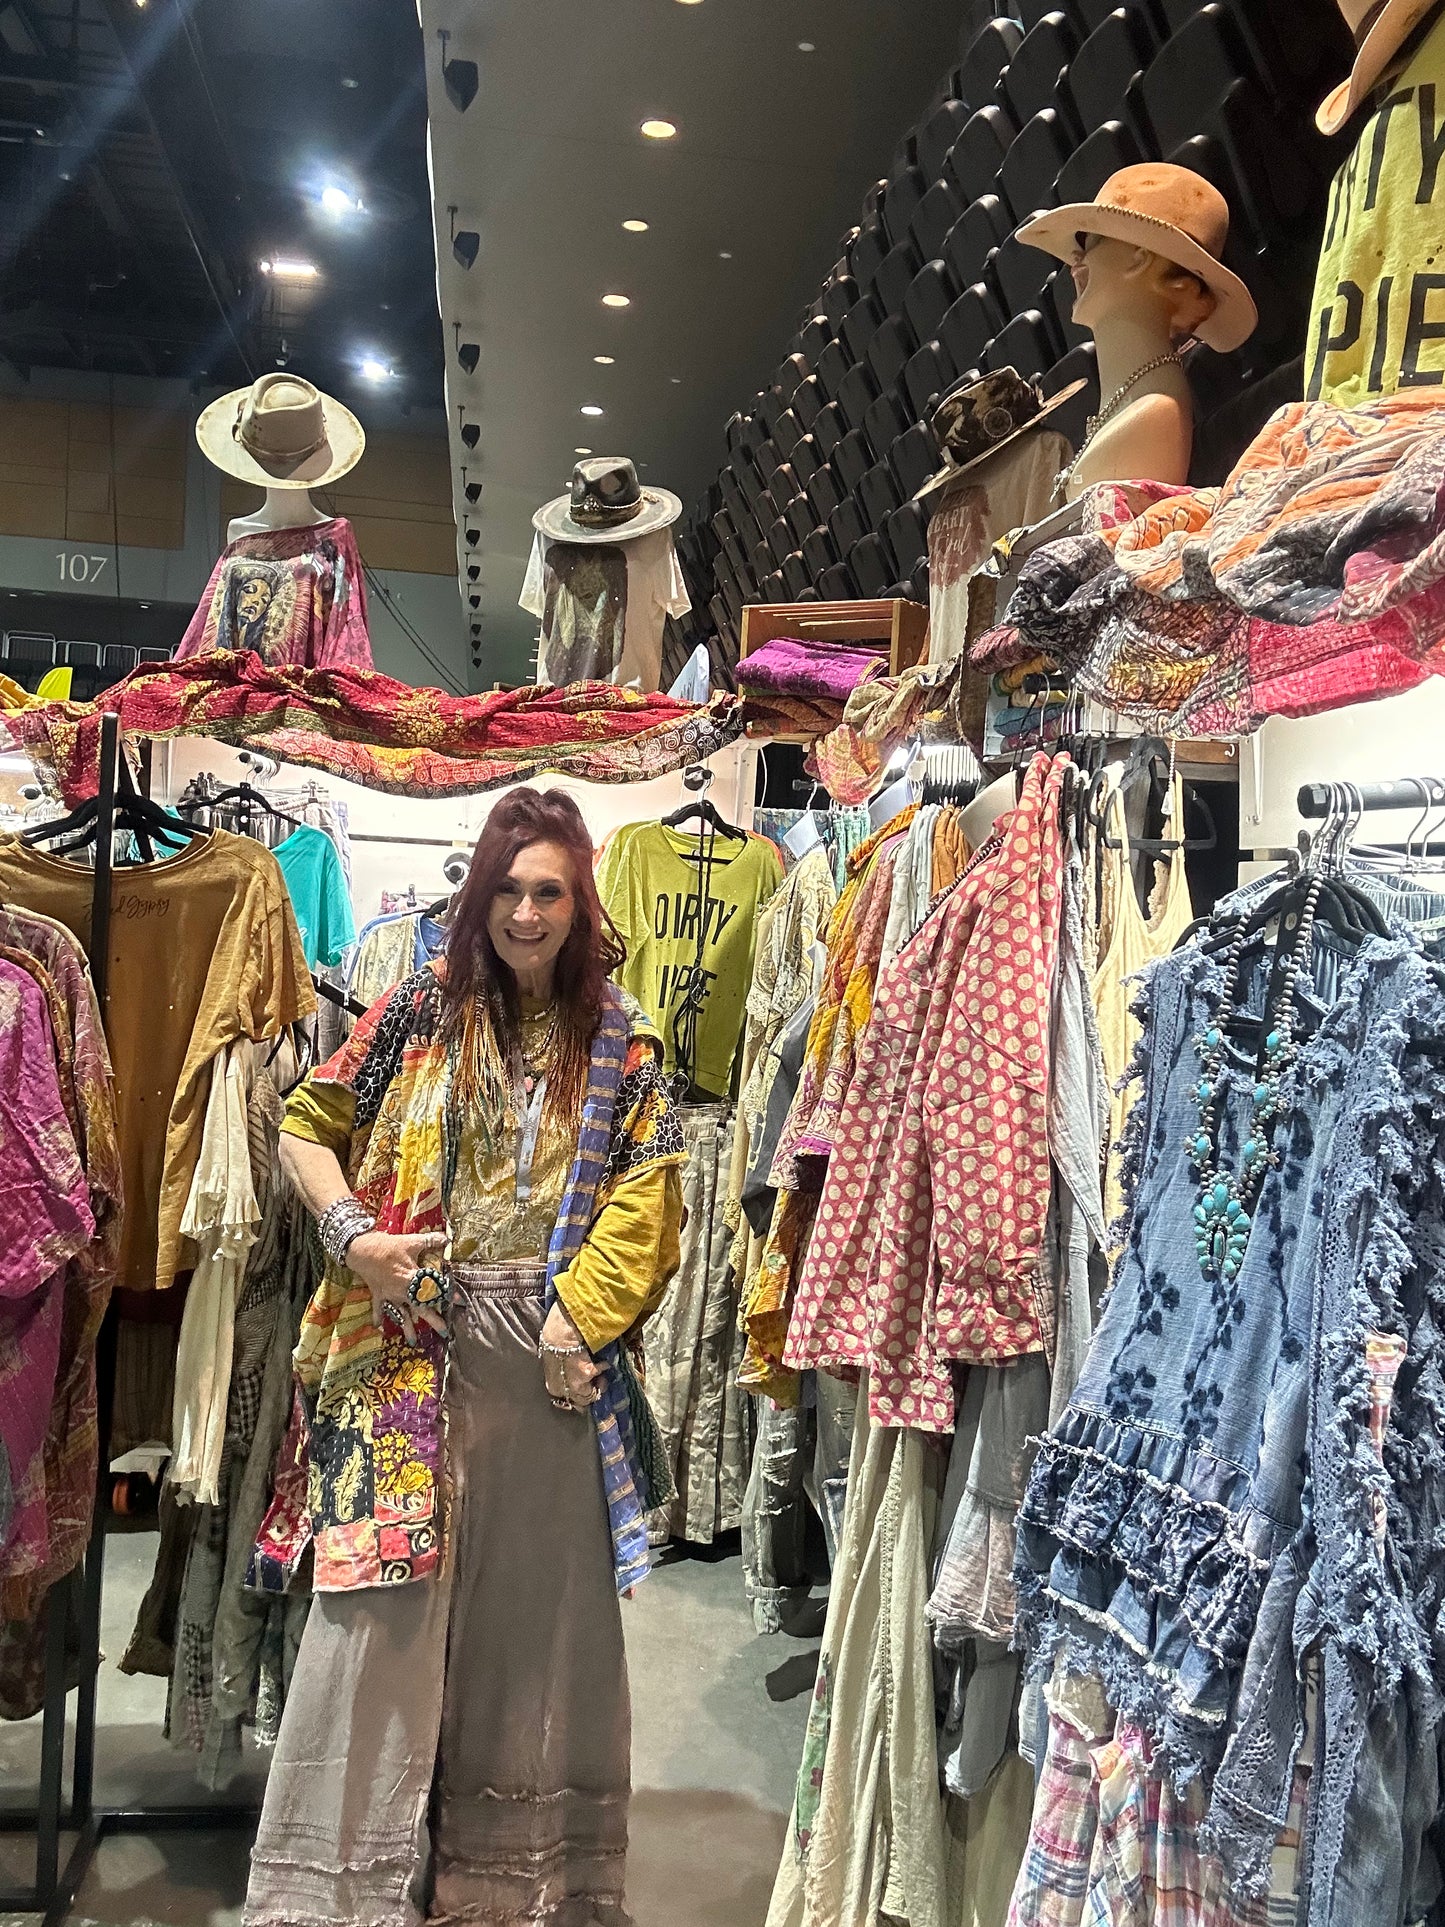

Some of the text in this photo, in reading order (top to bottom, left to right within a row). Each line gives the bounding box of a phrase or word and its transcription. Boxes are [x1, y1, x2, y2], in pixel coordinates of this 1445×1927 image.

[1306, 273, 1445, 401] PIE
[55, 552, 108, 583] 107
[655, 892, 738, 945] DIRTY
